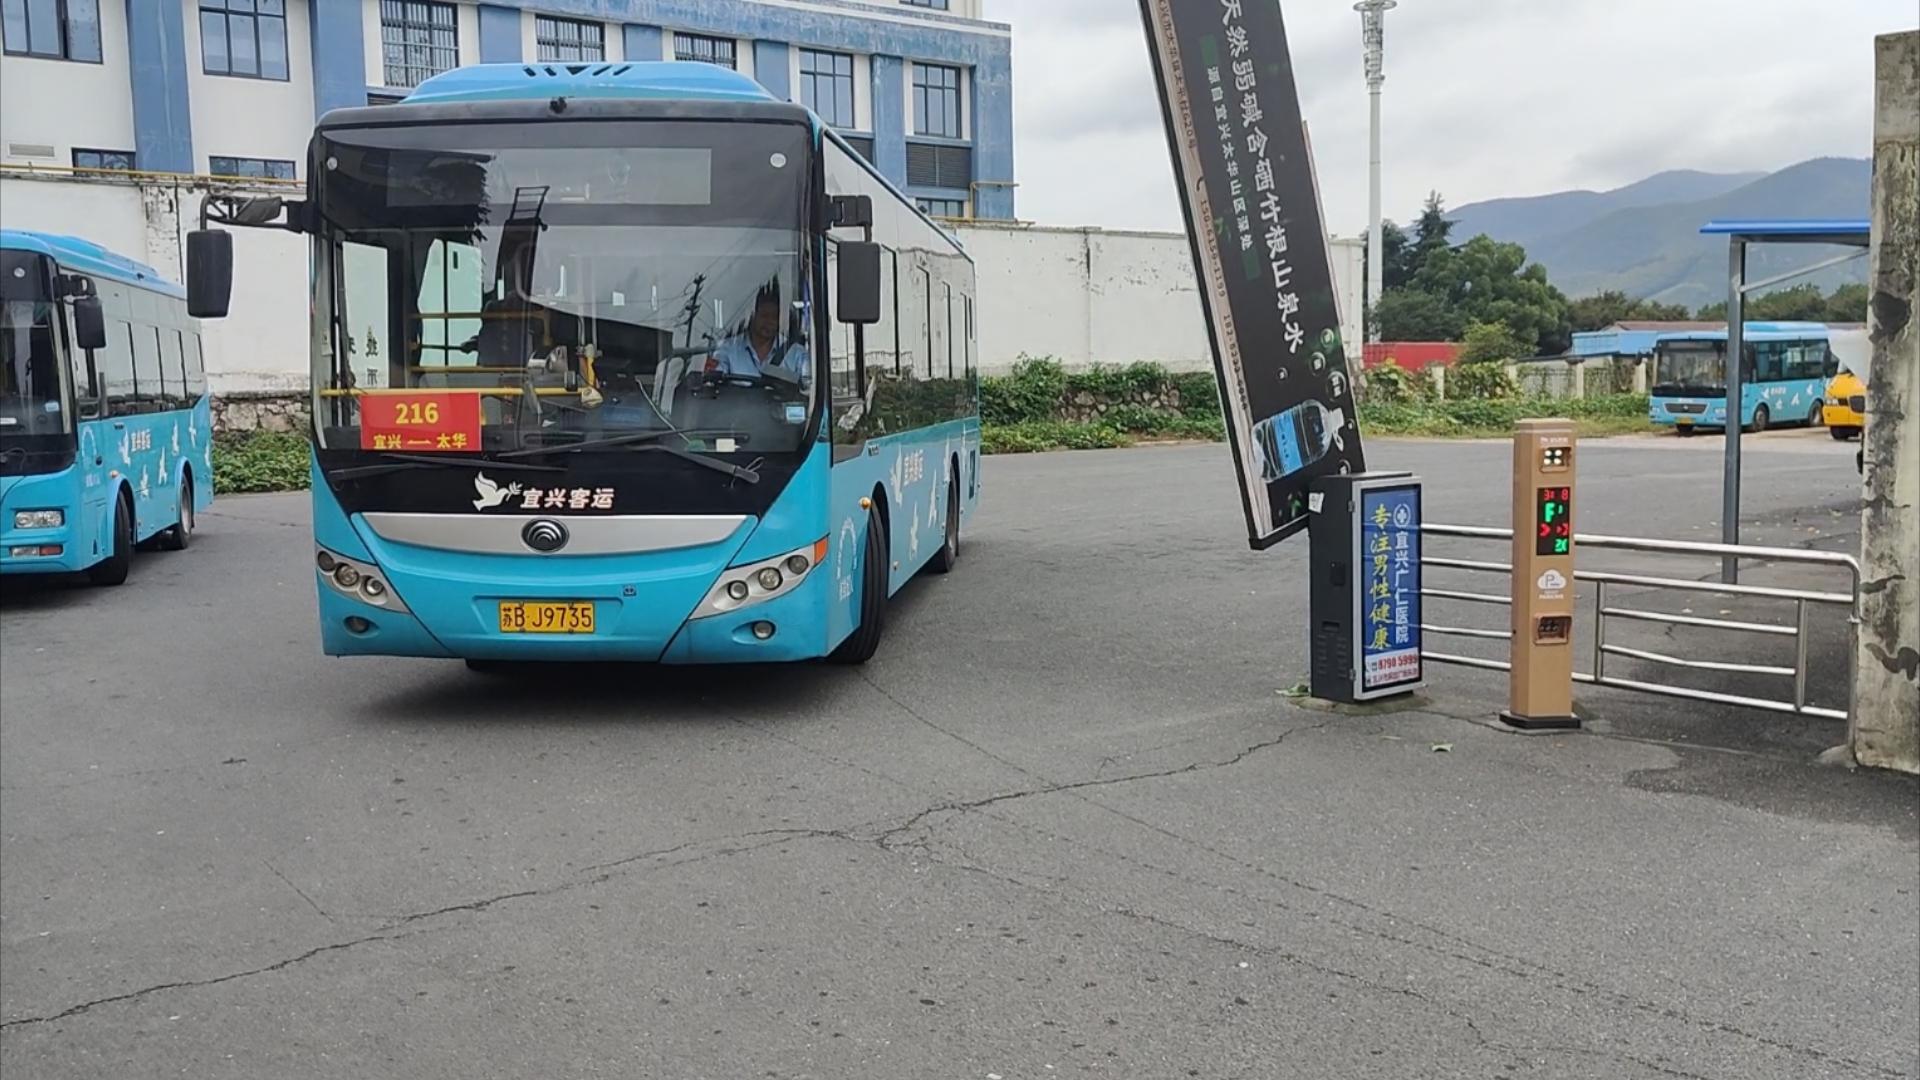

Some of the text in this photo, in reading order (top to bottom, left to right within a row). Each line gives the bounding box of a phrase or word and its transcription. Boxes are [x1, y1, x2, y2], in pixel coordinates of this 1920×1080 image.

[1207, 66, 1254, 251] 源自宜兴太华山区深处
[395, 401, 440, 425] 216
[520, 487, 614, 509] 宜兴客运
[1369, 503, 1393, 650] 专注男性健康
[1394, 531, 1410, 644] 宜兴广仁医院
